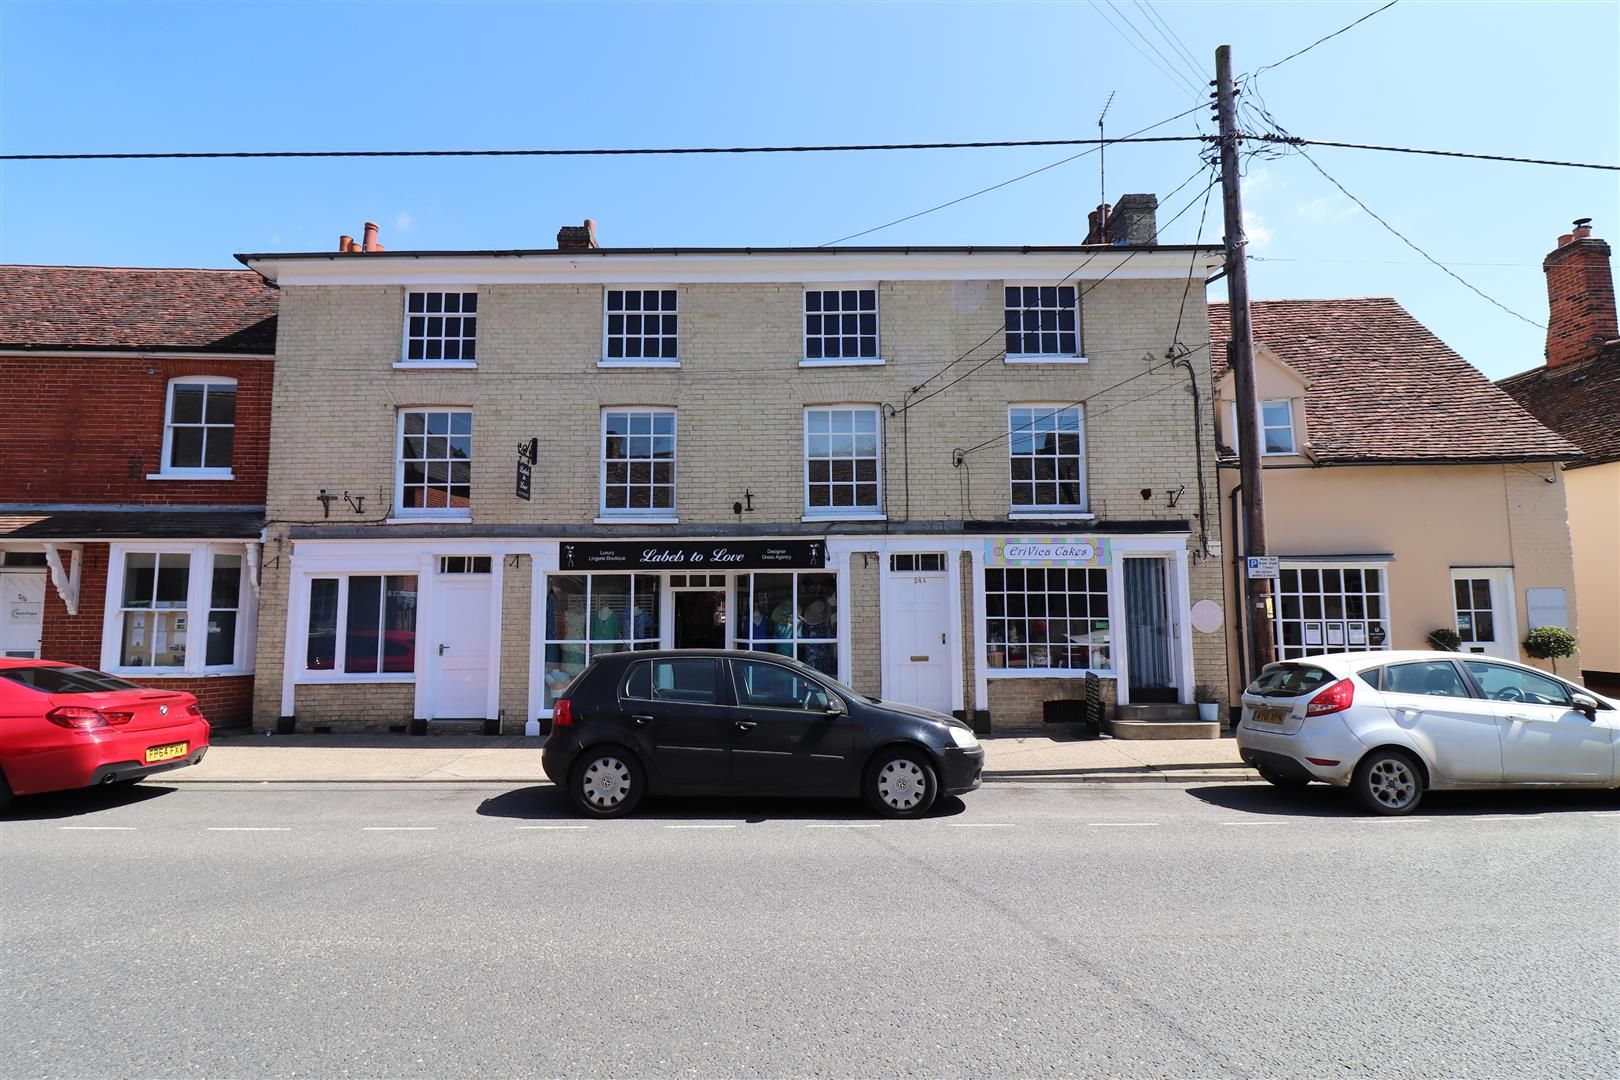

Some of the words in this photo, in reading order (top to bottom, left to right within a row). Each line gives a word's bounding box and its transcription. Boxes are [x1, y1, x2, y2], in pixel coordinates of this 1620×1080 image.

[639, 548, 685, 562] Labels
[689, 551, 704, 562] to
[709, 548, 745, 562] Love
[1055, 546, 1088, 557] Cakes
